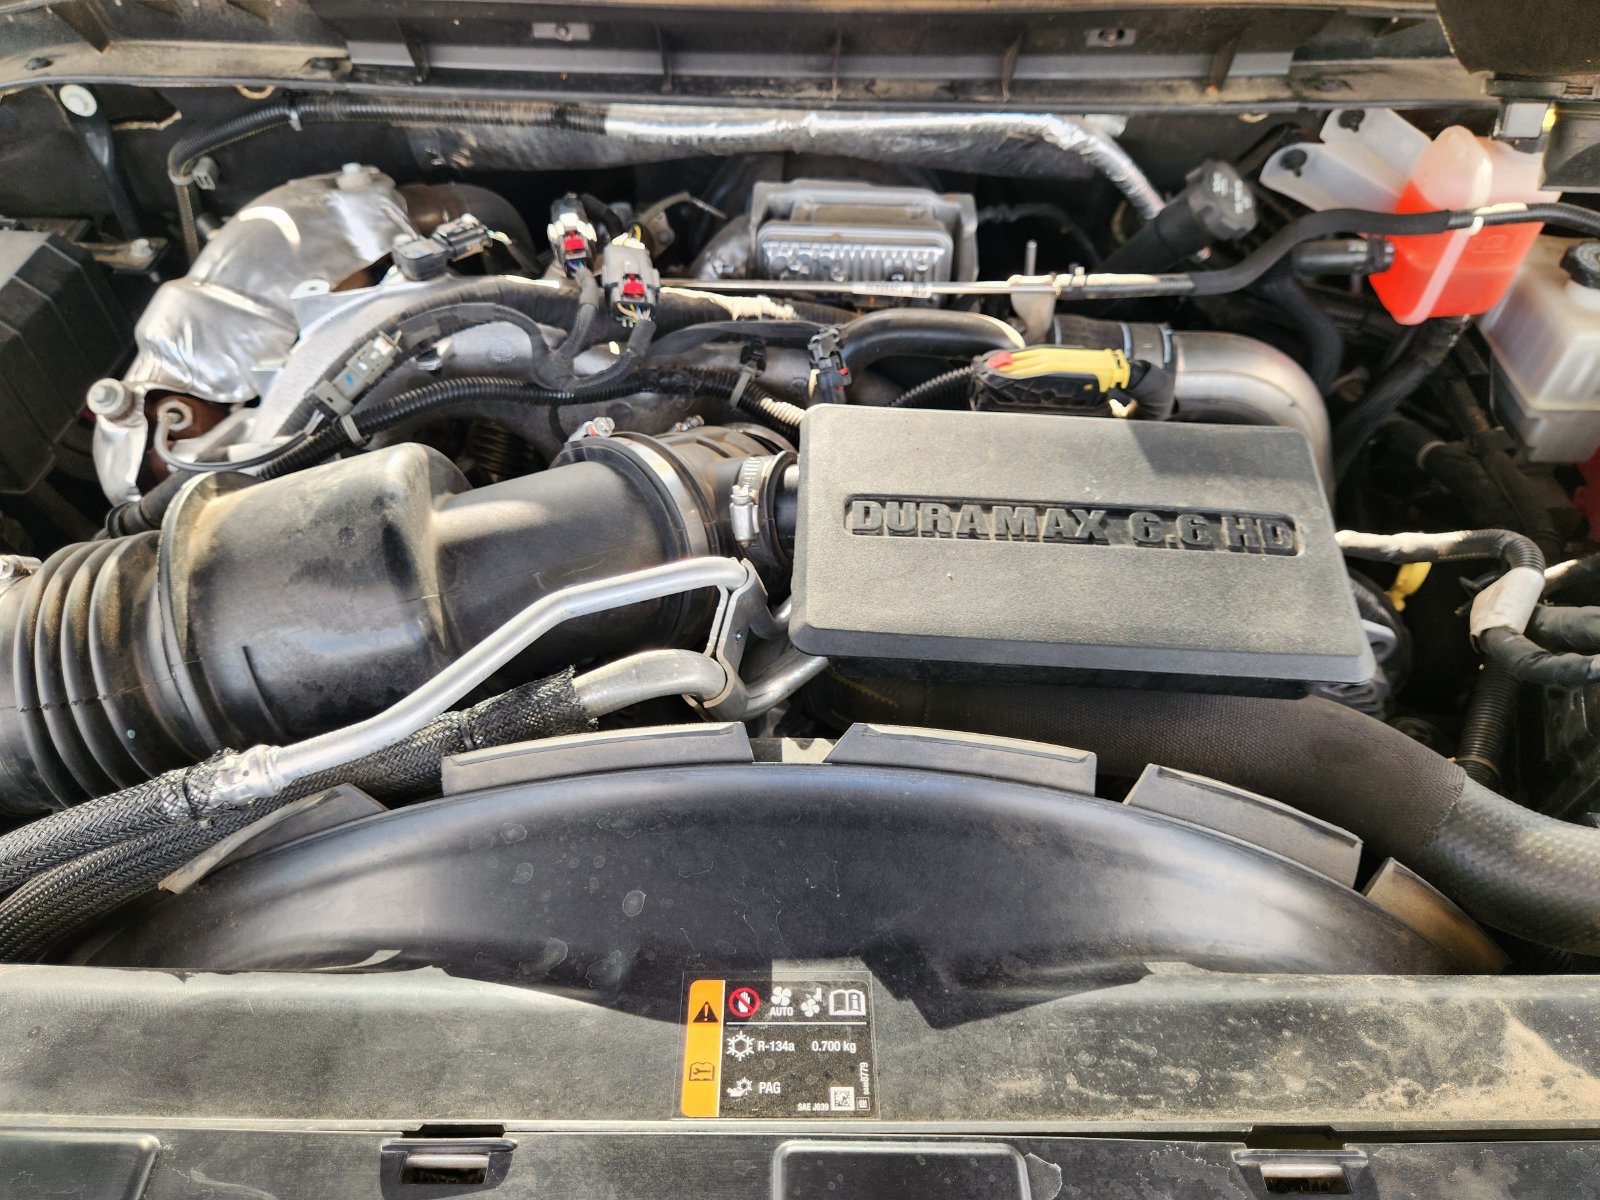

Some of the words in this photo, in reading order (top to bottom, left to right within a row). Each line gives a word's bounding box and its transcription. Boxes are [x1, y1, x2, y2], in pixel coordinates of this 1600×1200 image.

[850, 499, 1109, 544] DURAMAX
[1129, 511, 1217, 549] 6.6
[1220, 515, 1295, 556] HD
[769, 1006, 794, 1017] AUTO
[757, 1040, 795, 1052] R-134a
[811, 1040, 841, 1052] 0.700
[843, 1040, 857, 1054] kg
[759, 1081, 781, 1095] PAG
[797, 1102, 811, 1112] SAE
[812, 1102, 829, 1112] J639
